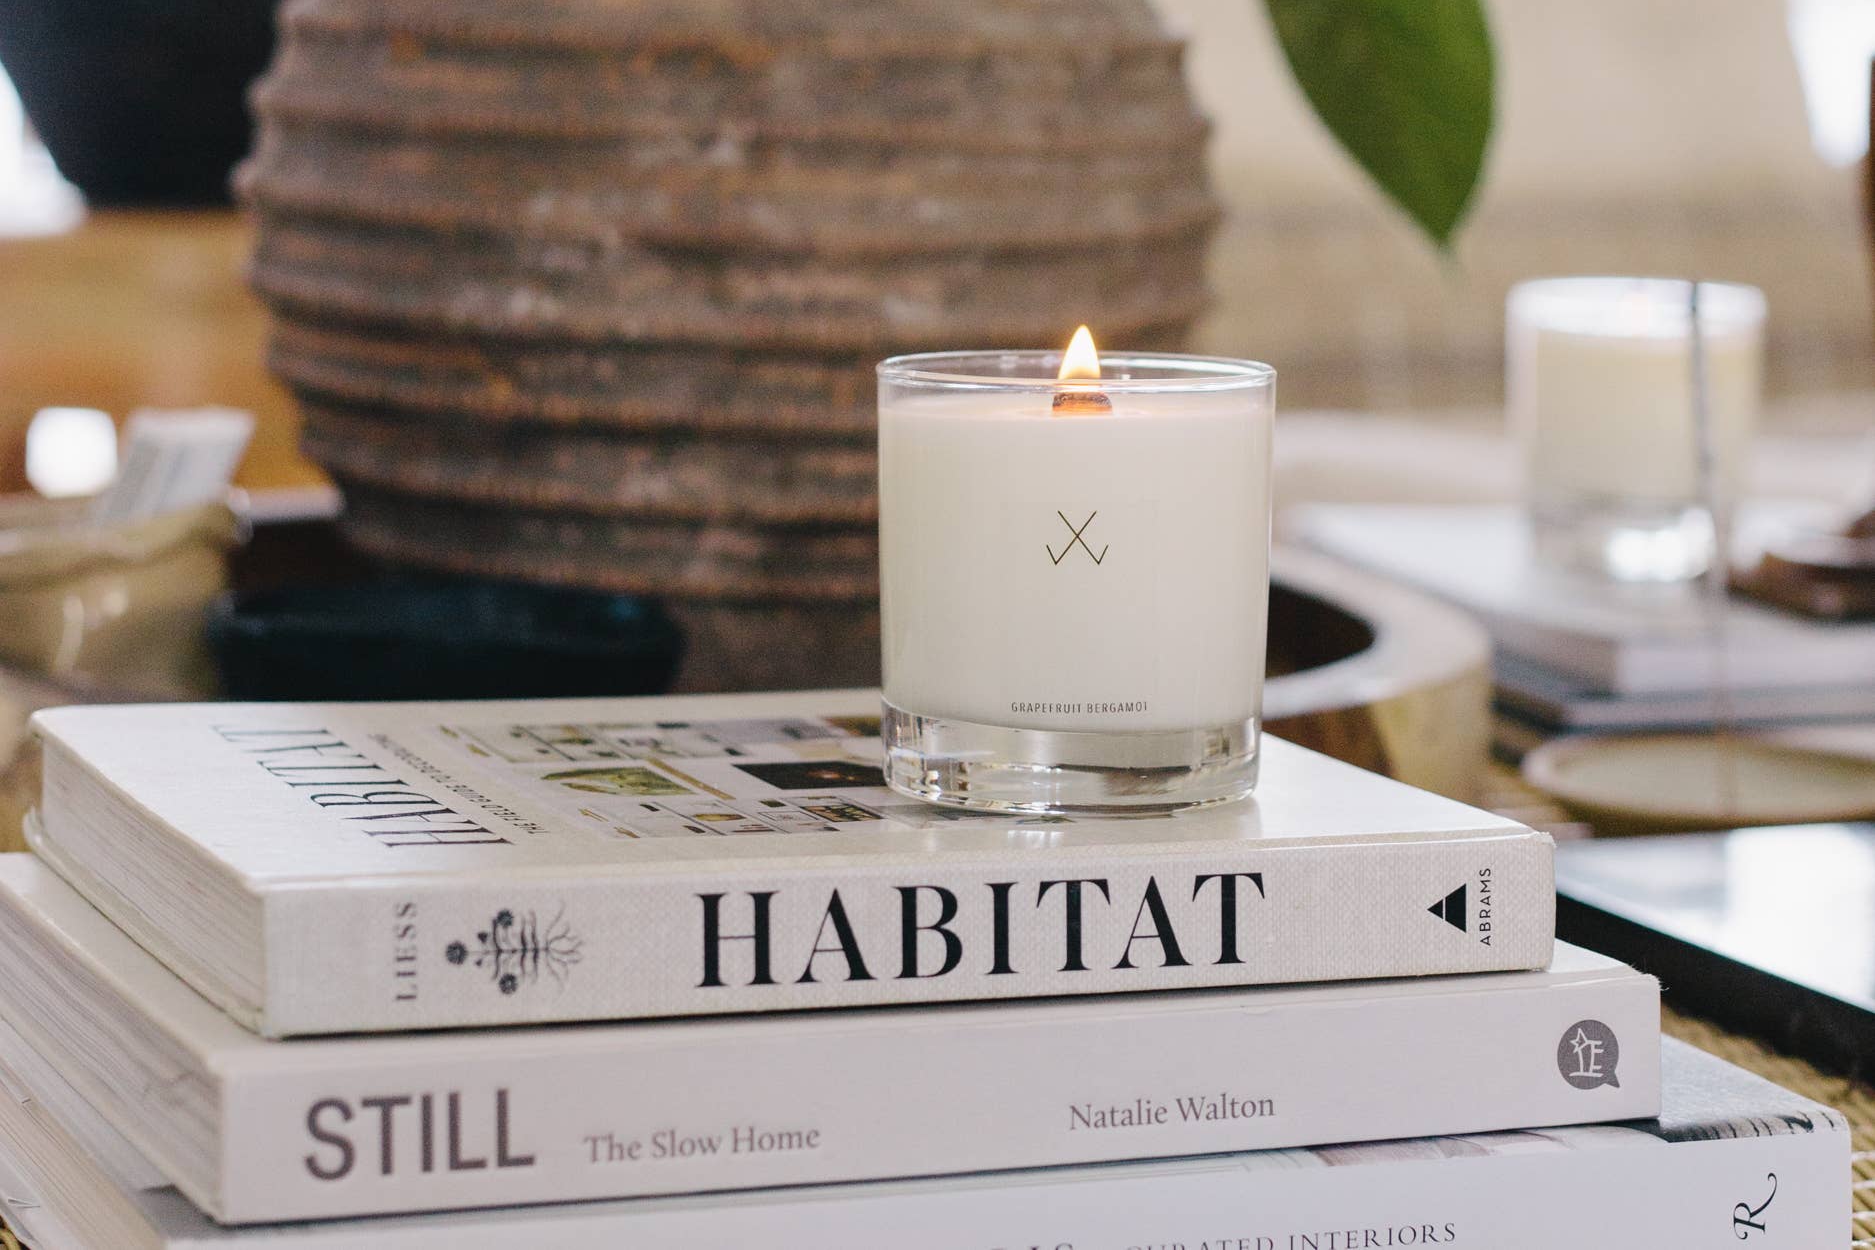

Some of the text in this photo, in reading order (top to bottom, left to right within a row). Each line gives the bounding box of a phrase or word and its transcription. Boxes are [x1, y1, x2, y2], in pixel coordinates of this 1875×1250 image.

[1011, 701, 1148, 714] GRAPEFRUIT BERGAMOT
[208, 724, 514, 847] HABITAT
[480, 805, 528, 821] FIELD
[513, 822, 551, 835] THE
[1478, 867, 1493, 947] ABRAMS
[695, 872, 1265, 988] HABITAT
[394, 902, 418, 1002] LIESS
[1069, 1092, 1275, 1131] Natalie Walton
[303, 1088, 536, 1182] STILL
[584, 1126, 821, 1163] The Slow Home
[1289, 1223, 1456, 1250] INTERIORS
